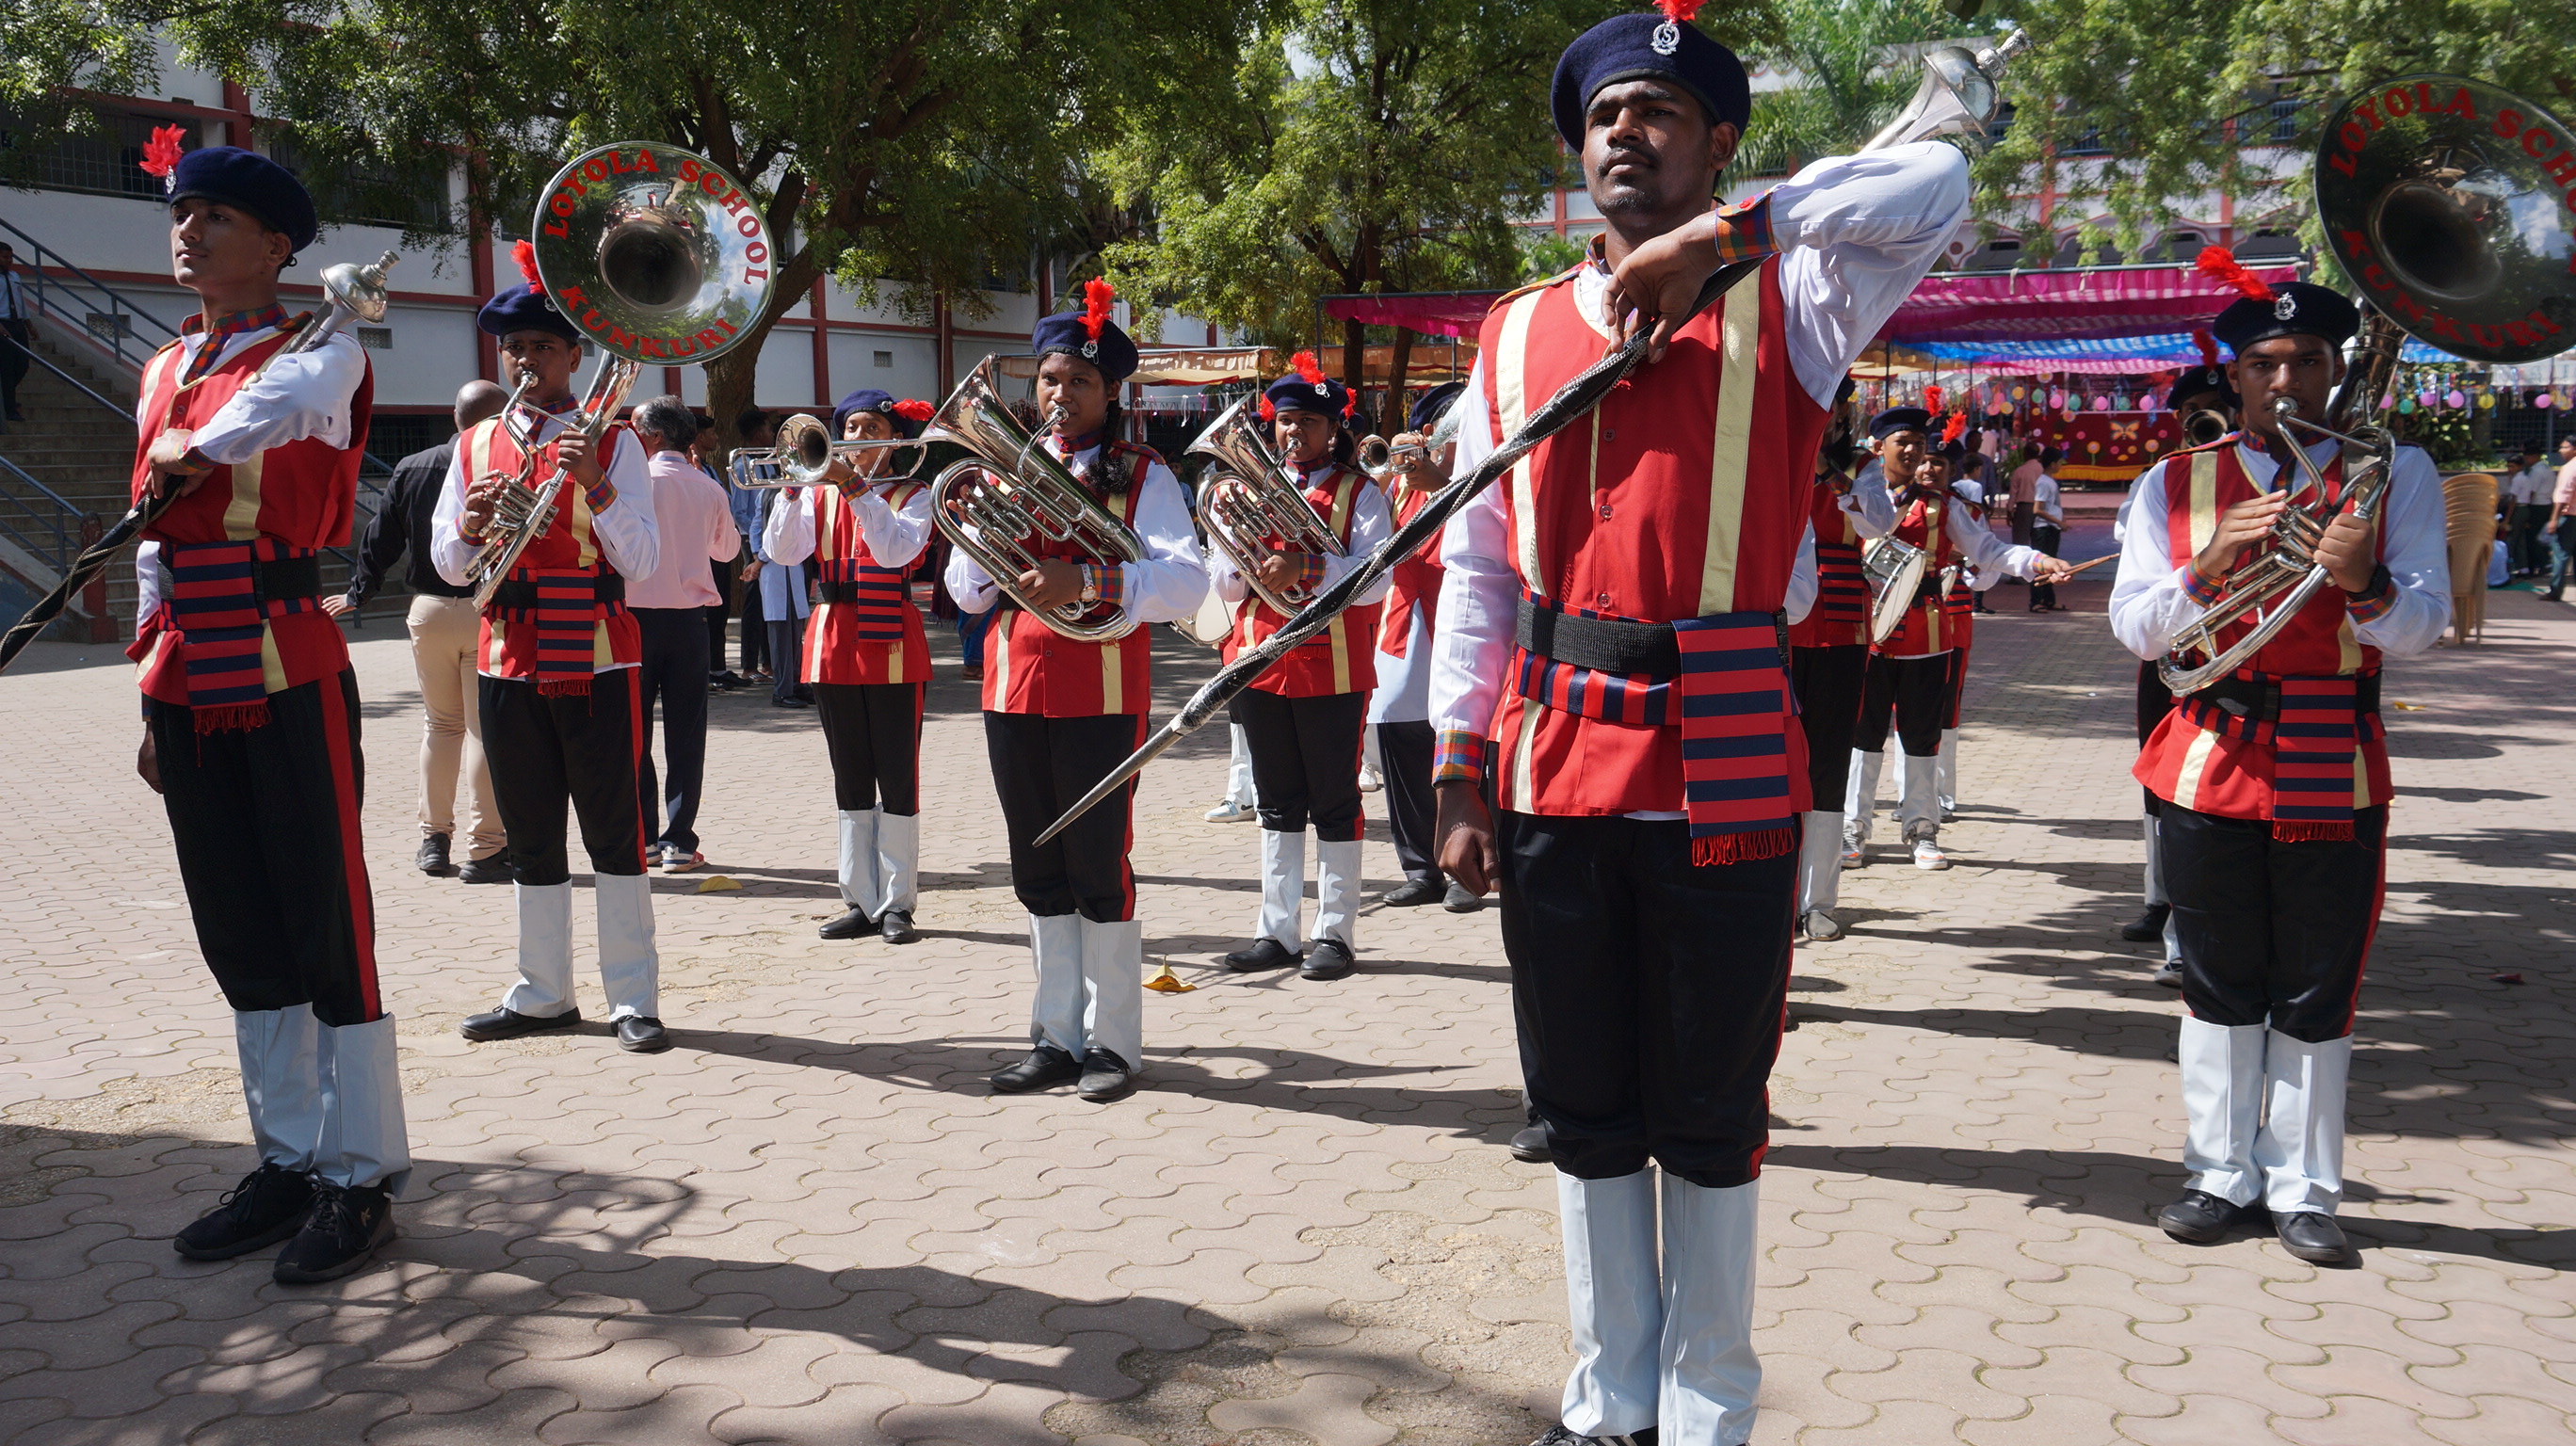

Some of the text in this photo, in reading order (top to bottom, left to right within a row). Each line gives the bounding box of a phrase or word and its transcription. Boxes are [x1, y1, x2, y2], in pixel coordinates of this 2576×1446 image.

[544, 149, 768, 285] LOYOLA SCHOOL
[2330, 83, 2576, 275] LOYOLA SCH
[558, 285, 738, 358] KUNKURI
[2341, 230, 2562, 348] KUNKURI
